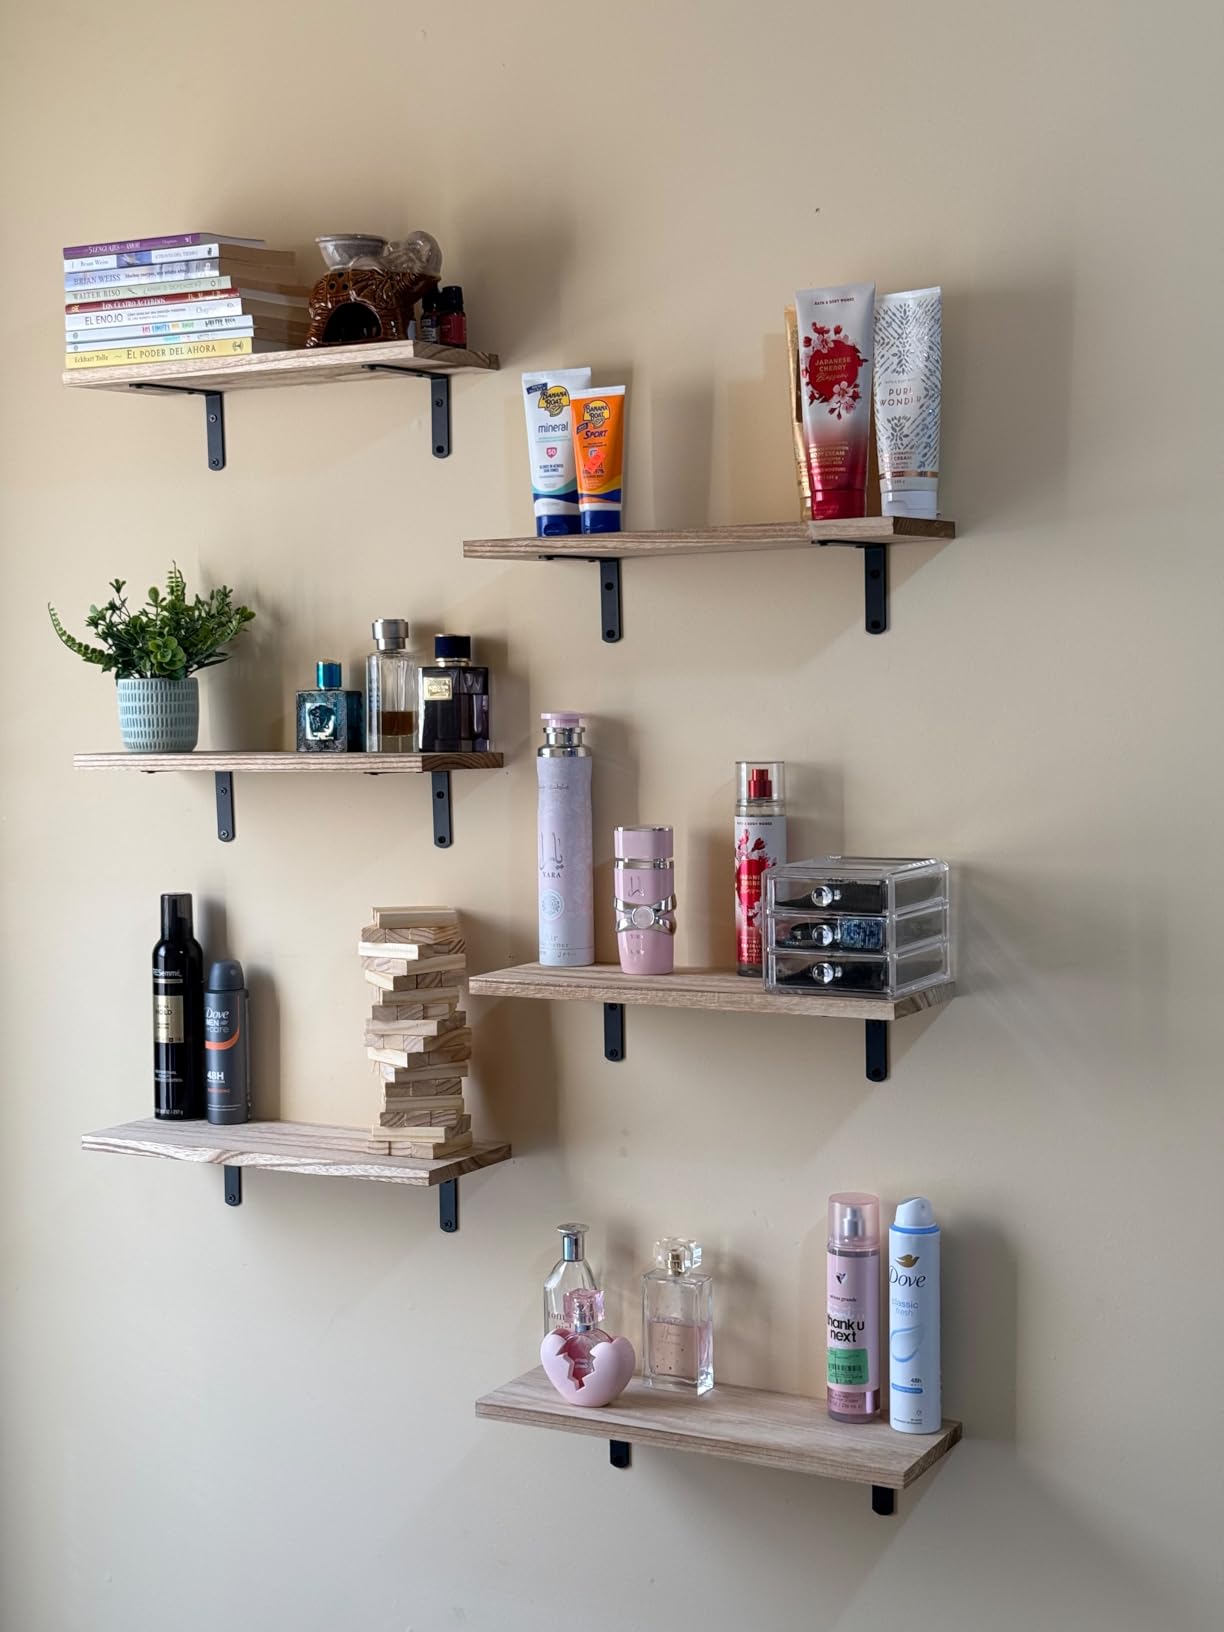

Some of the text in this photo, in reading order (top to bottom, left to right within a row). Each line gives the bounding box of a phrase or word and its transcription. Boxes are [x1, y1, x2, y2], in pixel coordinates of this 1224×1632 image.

[74, 274, 120, 286] BRIAN WEISS
[73, 289, 120, 300] WALTER RISO
[85, 316, 94, 325] EL
[96, 313, 123, 324] ENOJO
[140, 348, 166, 358] PODER
[170, 346, 186, 356] DEL
[815, 357, 851, 366] JAPANESE
[540, 390, 567, 400] BANANA
[544, 398, 562, 408] BOAT
[590, 411, 604, 419] BOAT
[538, 422, 569, 433] mineral
[584, 430, 608, 439] SPORT
[206, 1006, 229, 1019] Dove
[207, 1070, 224, 1080] 48H
[889, 1265, 926, 1287] Dove
[827, 1314, 864, 1330] hank u
[830, 1329, 856, 1342] next
